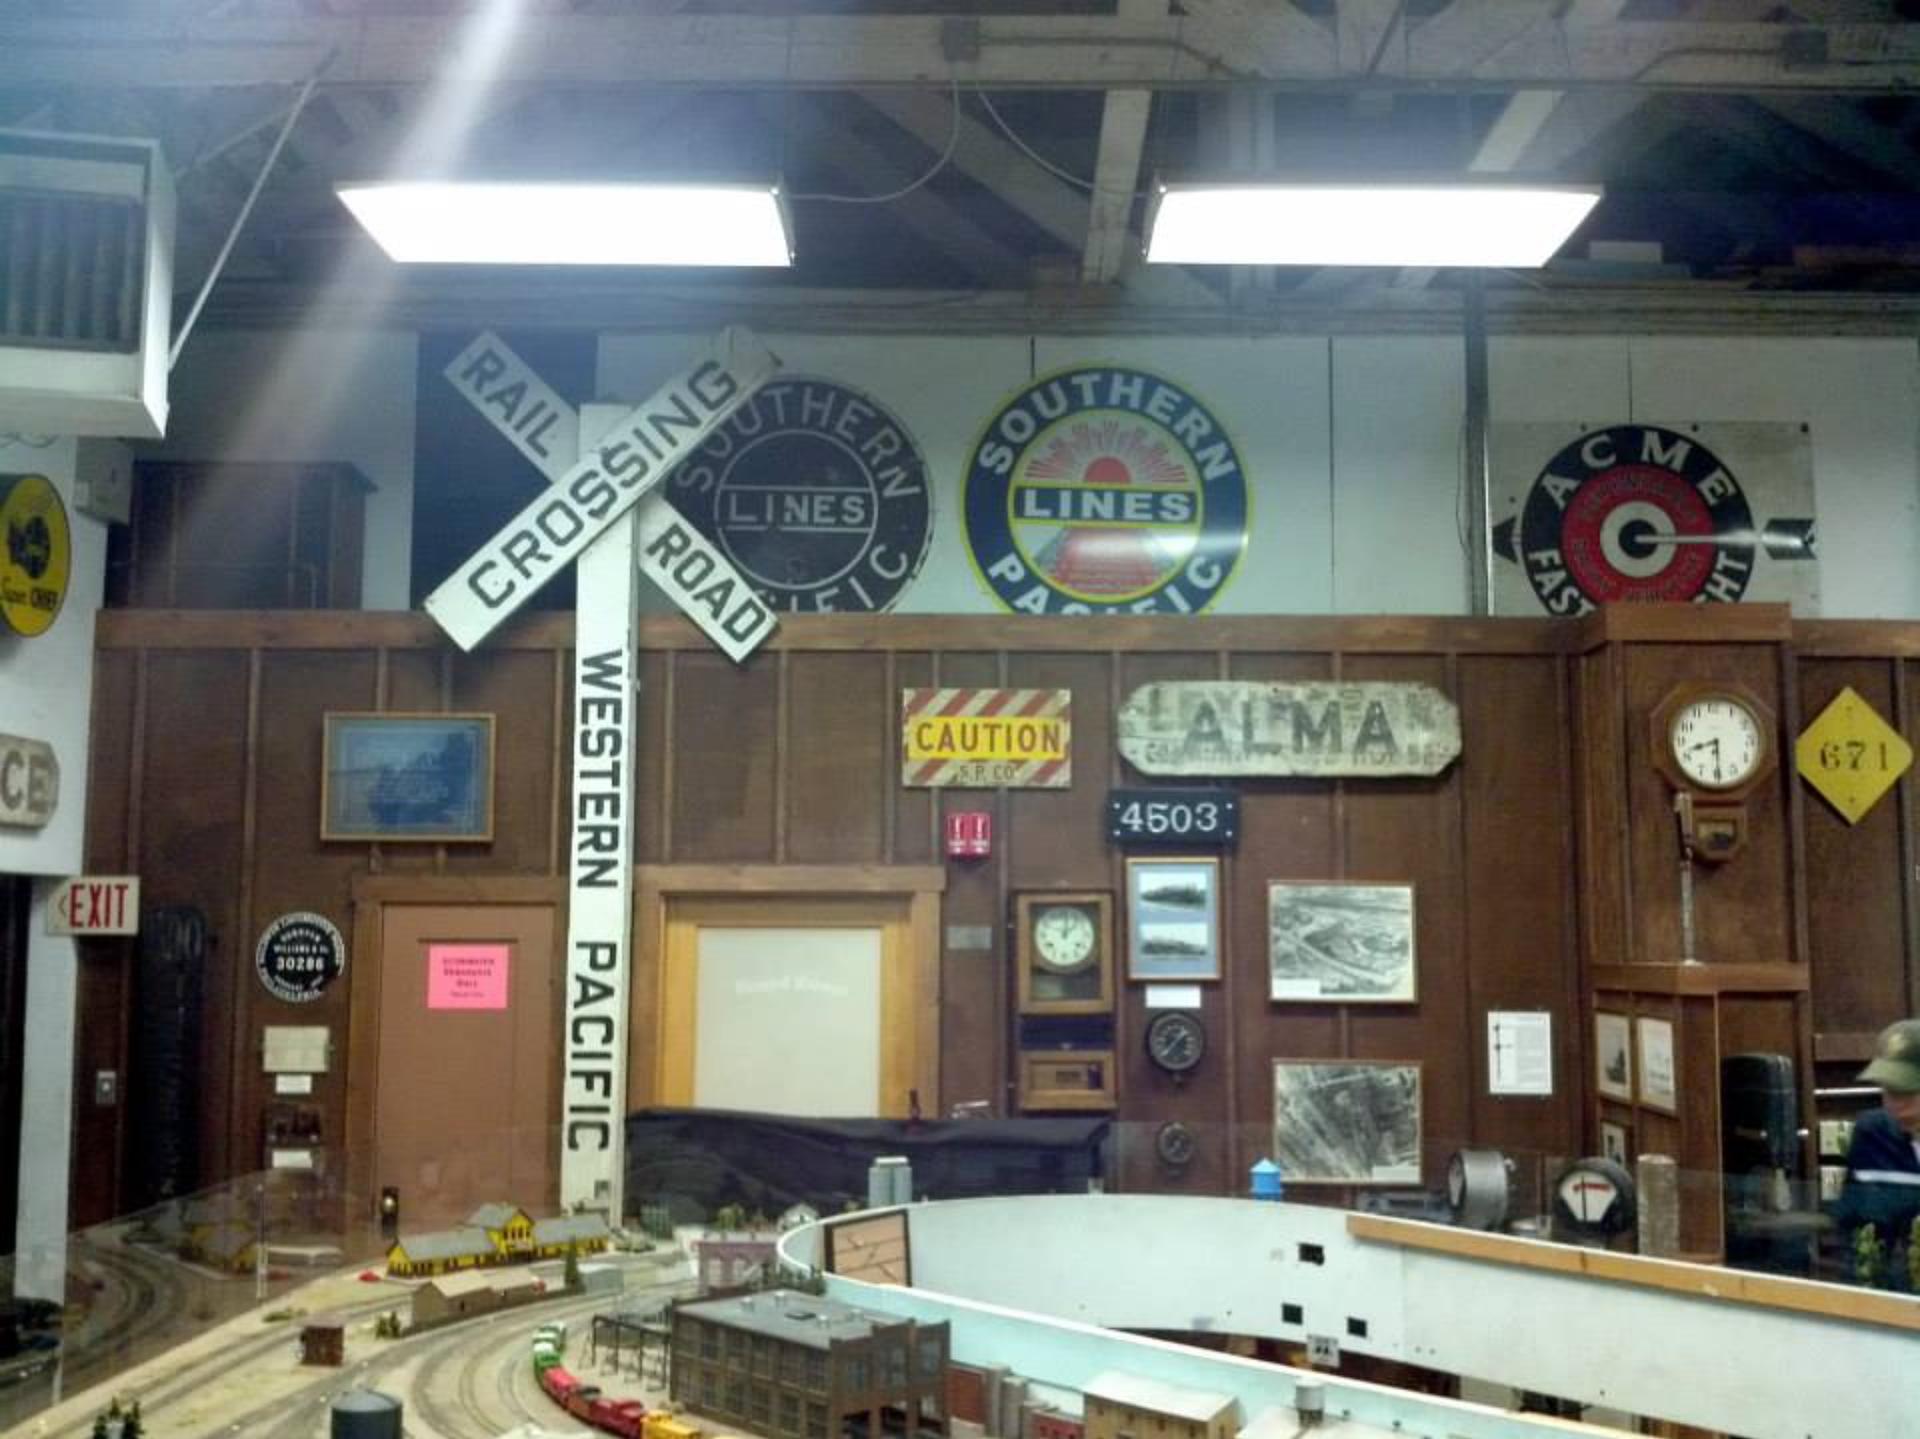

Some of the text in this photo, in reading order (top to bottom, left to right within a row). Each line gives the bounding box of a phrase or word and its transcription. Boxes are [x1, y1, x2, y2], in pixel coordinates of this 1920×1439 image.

[675, 384, 921, 501] SOUTHERN
[978, 372, 1236, 481] SOUTHERN
[460, 349, 767, 644] RAIL ROAD
[467, 360, 738, 609] CROSSING
[1541, 430, 1738, 512] ACME
[729, 493, 866, 525] LINES
[1023, 488, 1192, 521] LINES
[915, 722, 1061, 753] CAUTION
[1819, 740, 1889, 771] 671
[1120, 802, 1219, 834] 4503
[69, 883, 129, 929] EXIT
[567, 648, 623, 1151] WESTERN PACIFIC
